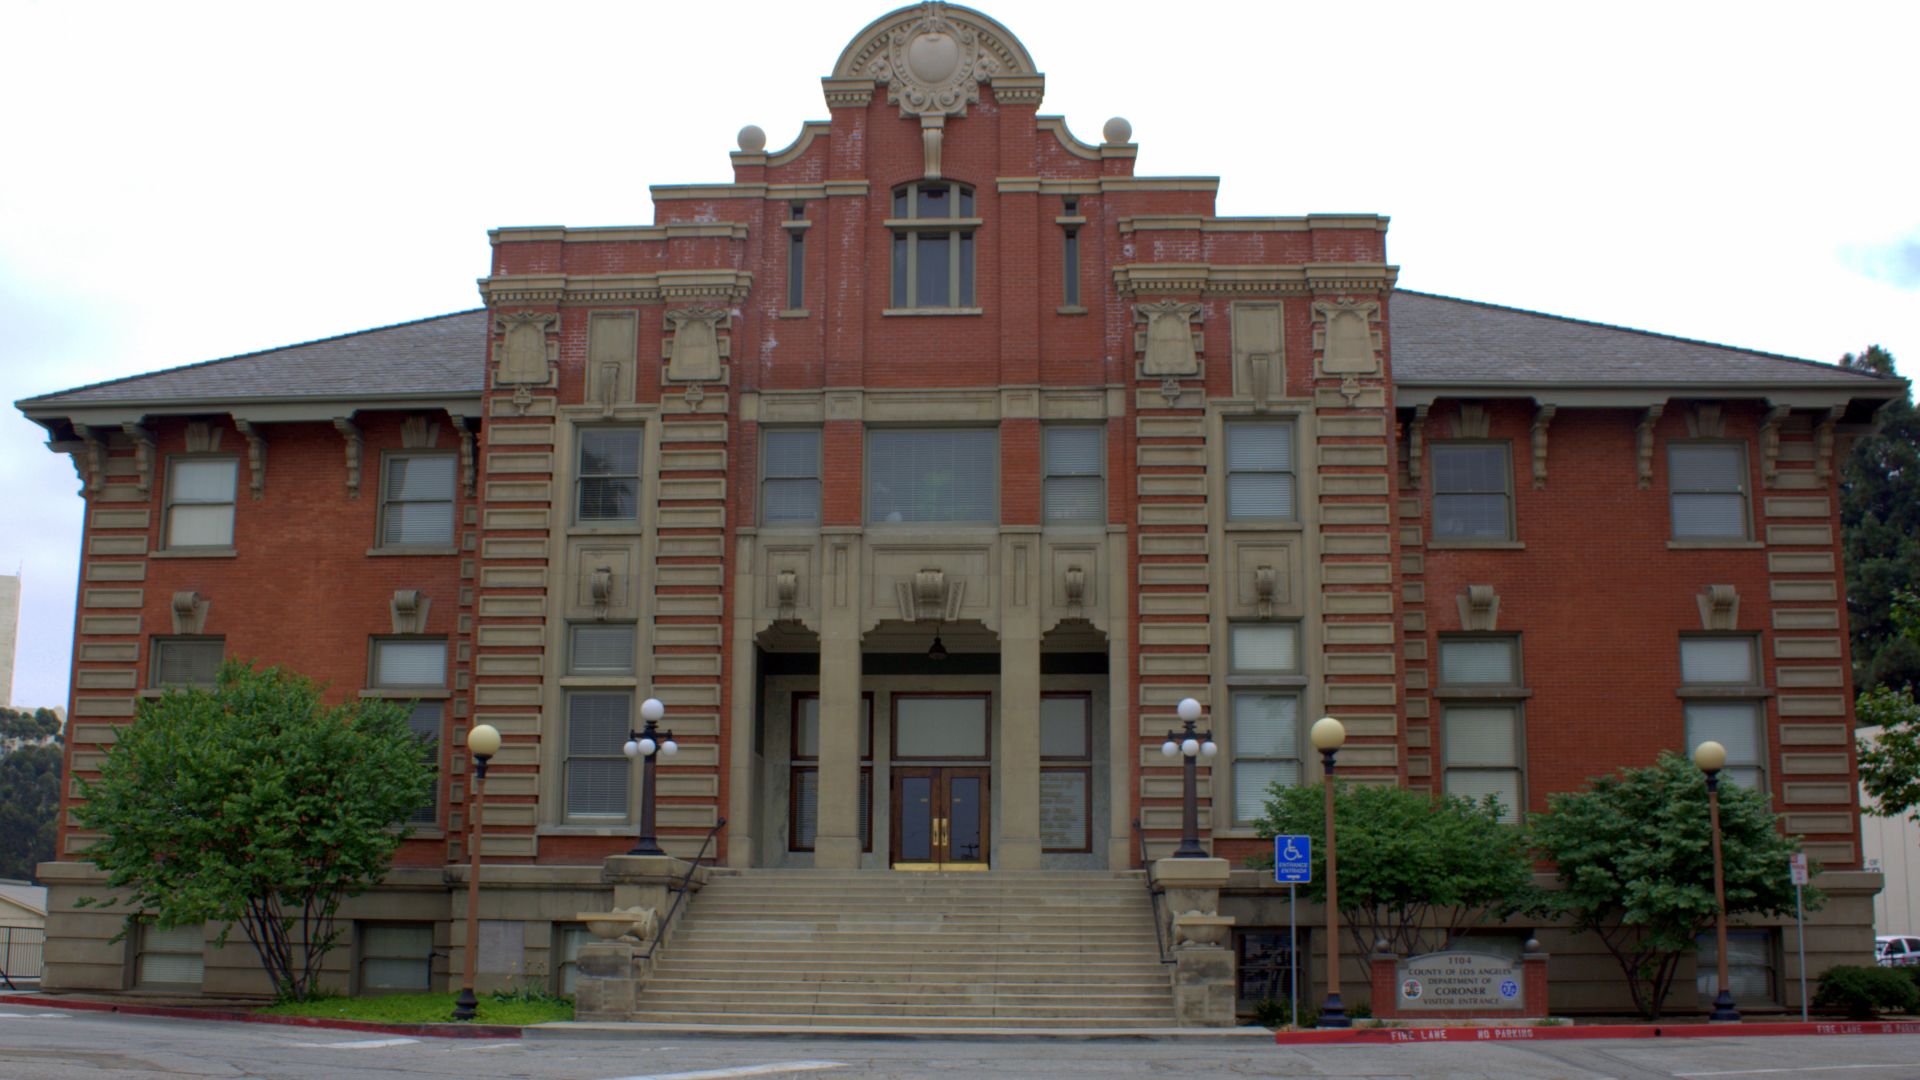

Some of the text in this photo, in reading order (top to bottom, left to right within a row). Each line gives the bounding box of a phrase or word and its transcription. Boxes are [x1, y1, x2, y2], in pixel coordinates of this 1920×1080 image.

[1448, 957, 1472, 965] 1104
[1434, 987, 1486, 996] CORONER
[1817, 1024, 1863, 1033] FIRE LANE
[1391, 1029, 1448, 1041] FIRE LANE
[1477, 1028, 1534, 1039] NO PARKING
